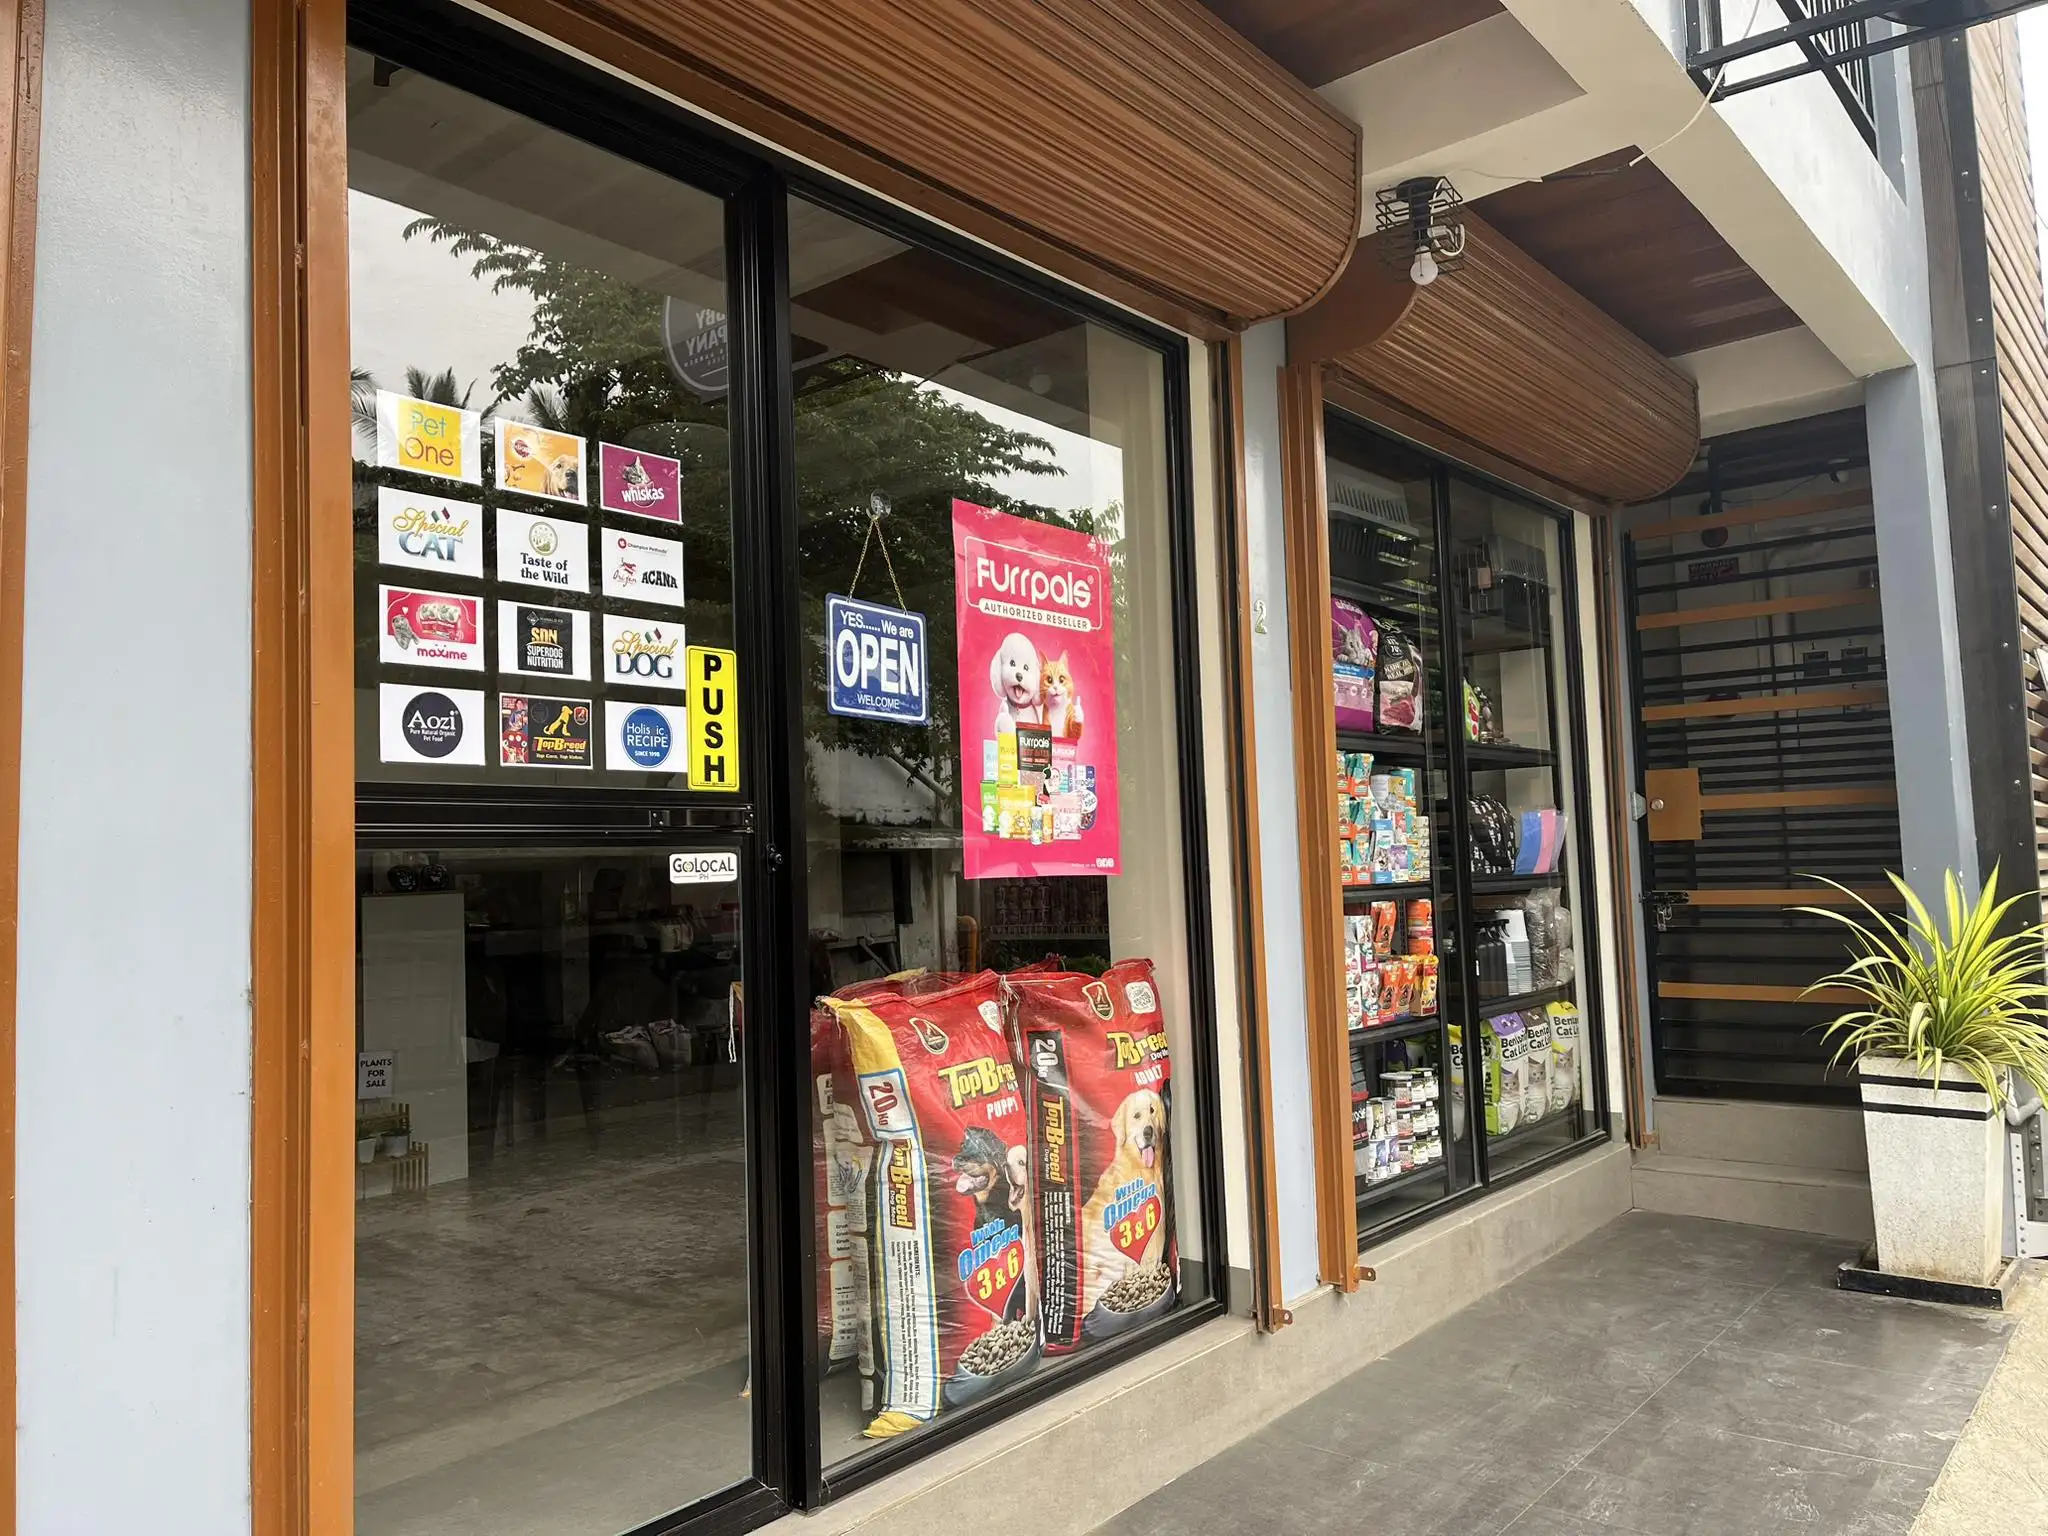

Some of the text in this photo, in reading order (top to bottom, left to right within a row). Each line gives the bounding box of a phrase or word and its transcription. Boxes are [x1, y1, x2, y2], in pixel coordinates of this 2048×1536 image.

[411, 410, 447, 438] Pet
[405, 437, 454, 466] One
[621, 486, 665, 502] whiskas
[393, 507, 469, 537] Special
[398, 531, 463, 562] CAT
[520, 552, 568, 571] Taste of
[521, 567, 568, 585] the Wild
[641, 570, 678, 589] ACANA
[977, 556, 1092, 608] Furrpals
[984, 602, 1088, 629] AUTHORIZED RESELLER
[881, 620, 897, 636] We
[899, 627, 914, 638] are
[416, 646, 468, 660] maxime
[527, 645, 563, 658] SUPERDOG
[612, 630, 678, 659] Special
[527, 656, 564, 669] NUTRITION
[616, 652, 673, 678] DOG
[836, 629, 920, 697] OPEN
[857, 694, 900, 709] WELCOME
[408, 710, 456, 730] Aozi
[702, 654, 725, 782] PUSH
[533, 736, 586, 751] TopBreed
[627, 735, 669, 748] RECIPE
[1556, 1026, 1572, 1036] Cat
[1502, 1047, 1517, 1058] Cat
[1529, 1038, 1545, 1049] Cat
[360, 1059, 392, 1068] PLANTS
[368, 1069, 385, 1077] FOR
[366, 1080, 386, 1088] SALE
[1043, 1096, 1065, 1184] TopBreed
[1119, 1203, 1156, 1248] 3 & 6
[977, 1248, 1019, 1300] 3 & 6
